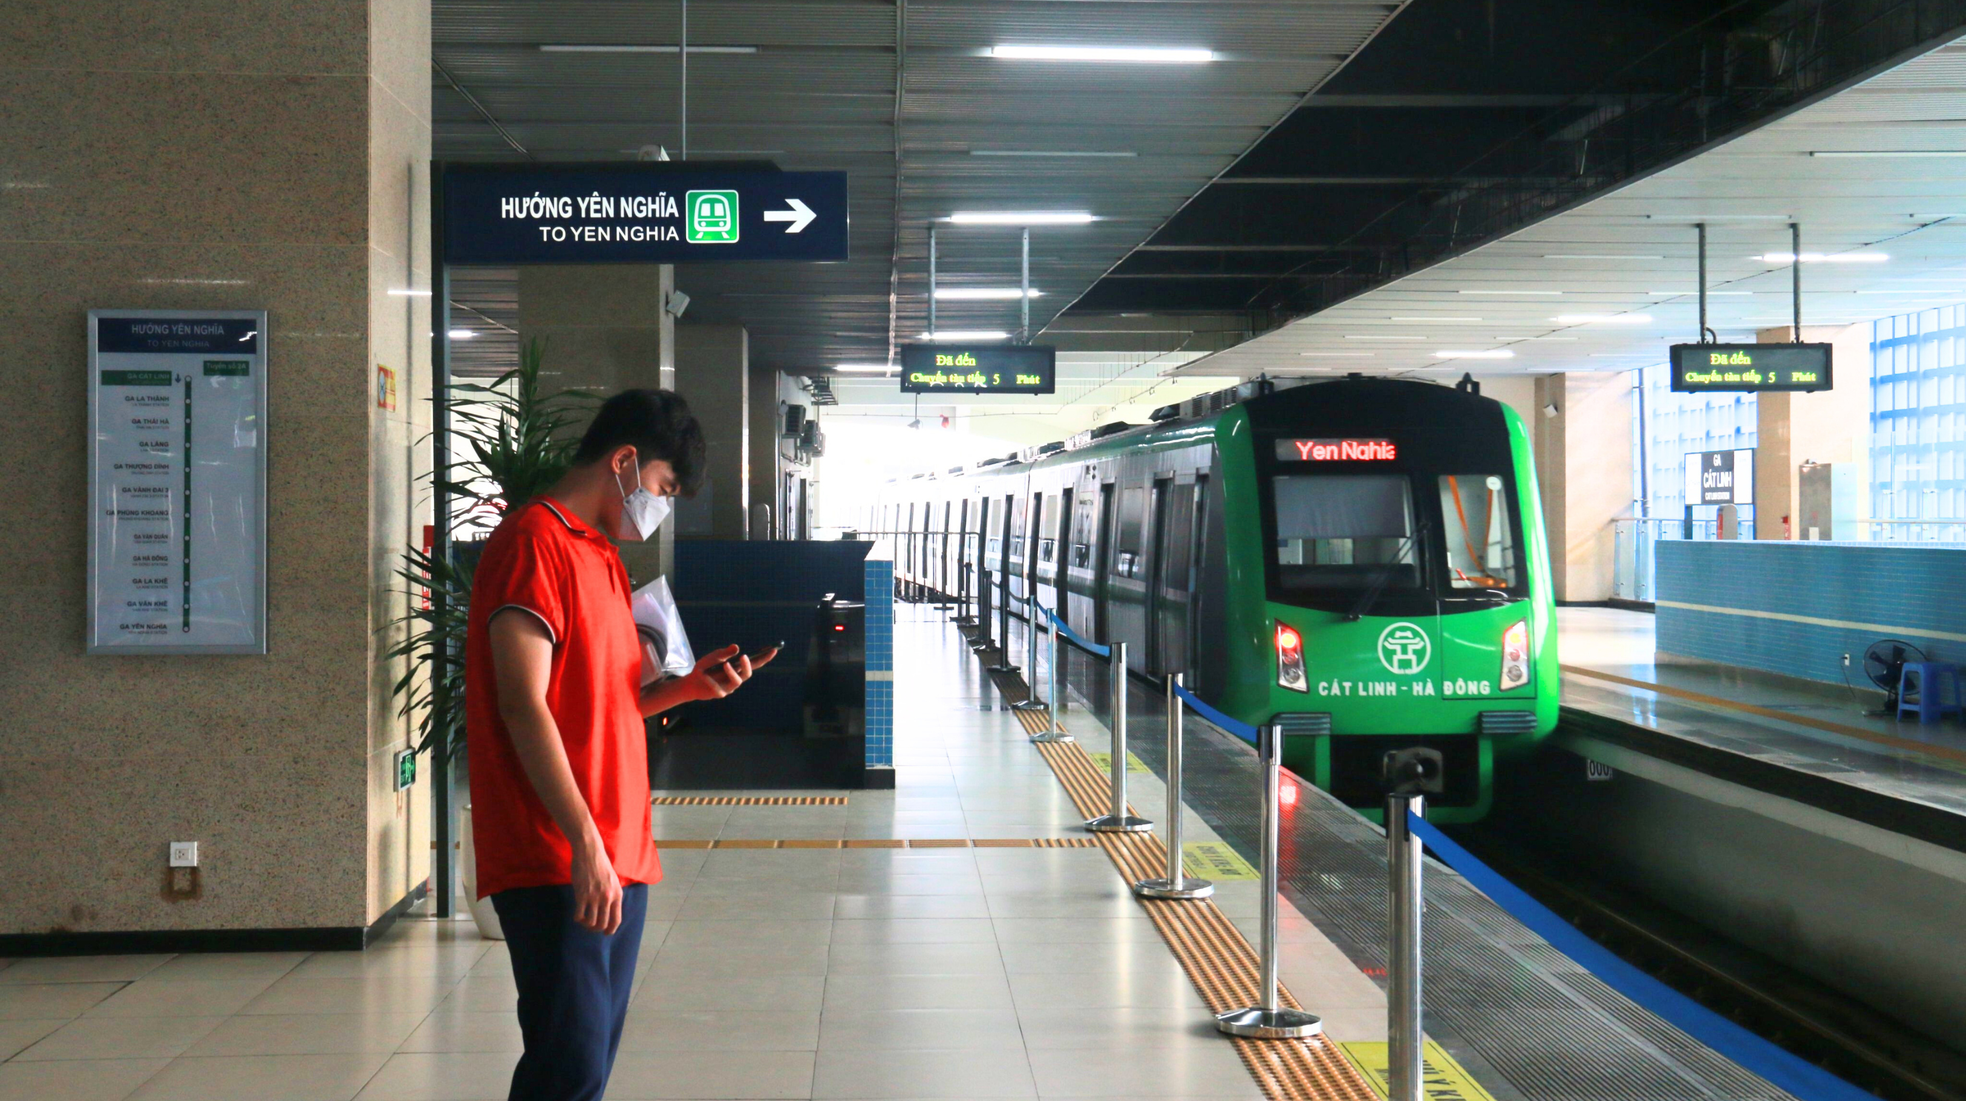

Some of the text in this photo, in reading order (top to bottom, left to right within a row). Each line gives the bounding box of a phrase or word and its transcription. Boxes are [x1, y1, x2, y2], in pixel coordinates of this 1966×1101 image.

[501, 191, 679, 219] HƯỚNG YÊN NGHĨA
[539, 226, 679, 242] TO YEN NGHIA
[131, 323, 169, 335] HƯỚNG
[171, 323, 191, 335] YÊN
[181, 340, 210, 348] NGHIA
[935, 353, 954, 366] Đã
[1710, 353, 1728, 365] Đã
[992, 373, 1000, 385] 5
[1768, 372, 1776, 383] 5
[1295, 441, 1339, 460] Yen
[1713, 453, 1721, 466] GA
[1318, 678, 1352, 696] CÁT
[1358, 681, 1397, 696] LINH
[1412, 679, 1435, 696] HÀ
[1443, 677, 1491, 696] ĐÔNG
